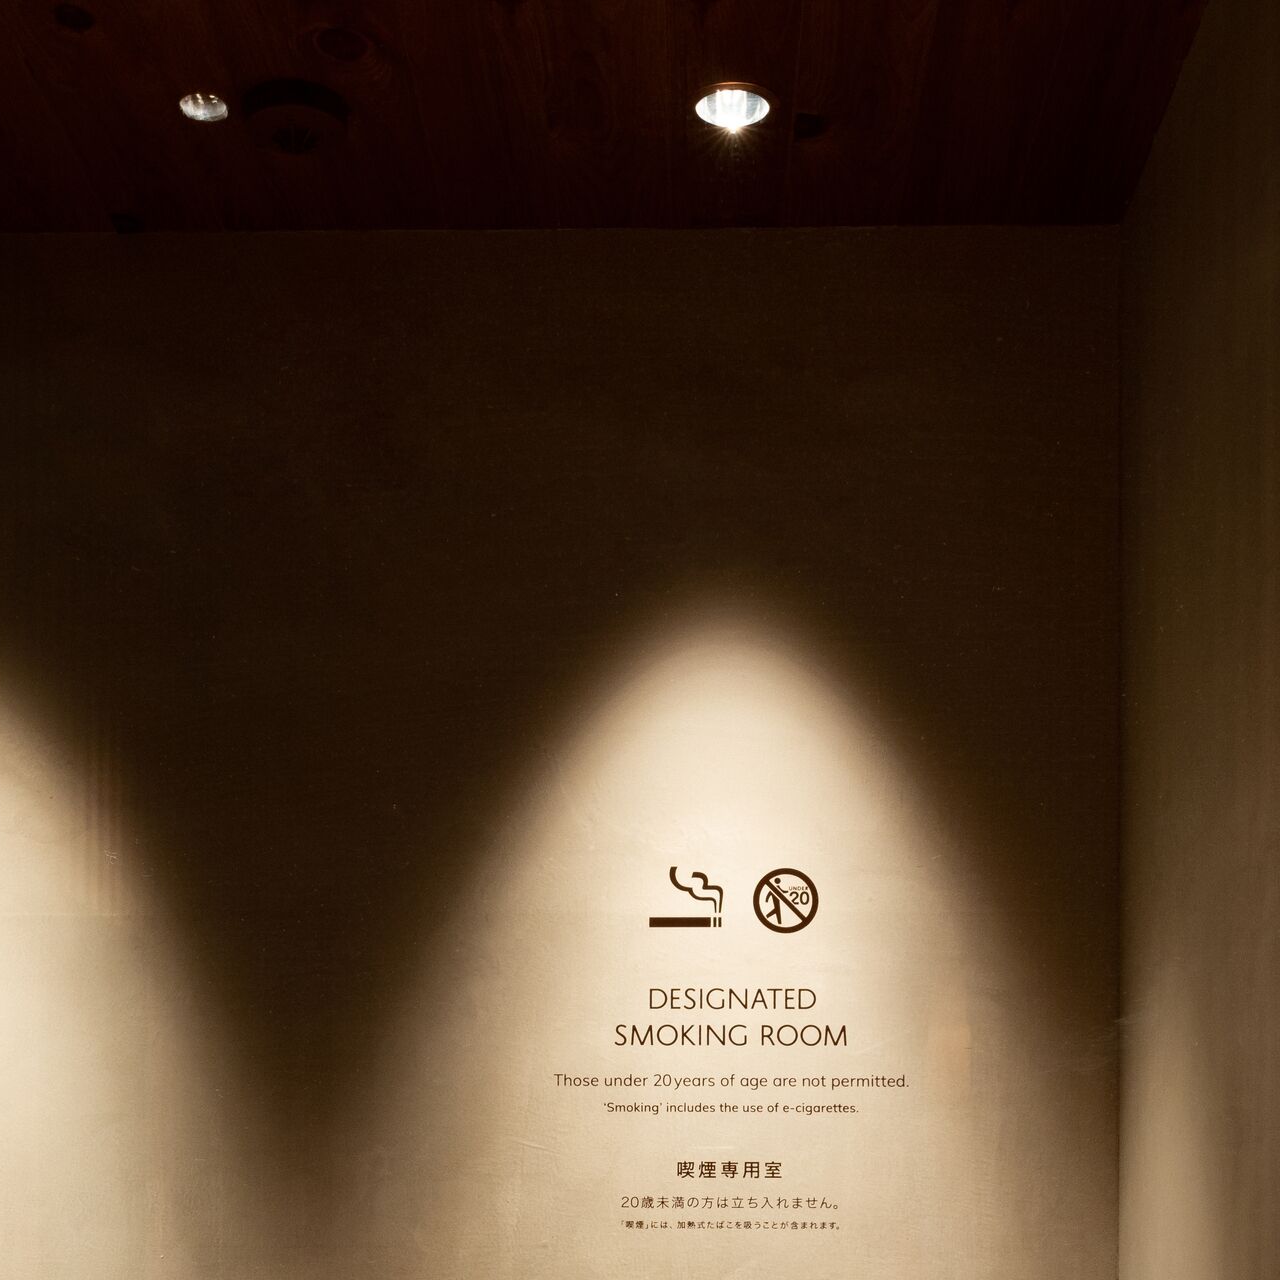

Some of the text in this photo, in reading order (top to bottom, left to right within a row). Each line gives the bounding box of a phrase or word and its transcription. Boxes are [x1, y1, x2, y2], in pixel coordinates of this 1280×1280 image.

[789, 891, 810, 905] 20
[649, 988, 816, 1010] DESIGNATED
[615, 1024, 847, 1046] SMOKING ROOM
[553, 1073, 600, 1088] Those
[604, 1073, 649, 1087] under
[720, 1073, 736, 1088] of
[739, 1077, 768, 1091] age
[772, 1077, 795, 1088] are
[801, 1075, 827, 1088] not
[831, 1074, 910, 1091] permitted.
[666, 1101, 716, 1113] includes
[719, 1102, 739, 1113] the
[742, 1104, 764, 1113] use
[766, 1101, 780, 1113] of
[782, 1102, 859, 1116] e-cigarettes.
[676, 1160, 783, 1179] 喫煙専用室
[620, 1195, 839, 1210] 20歳未満の方は立ち入れません。
